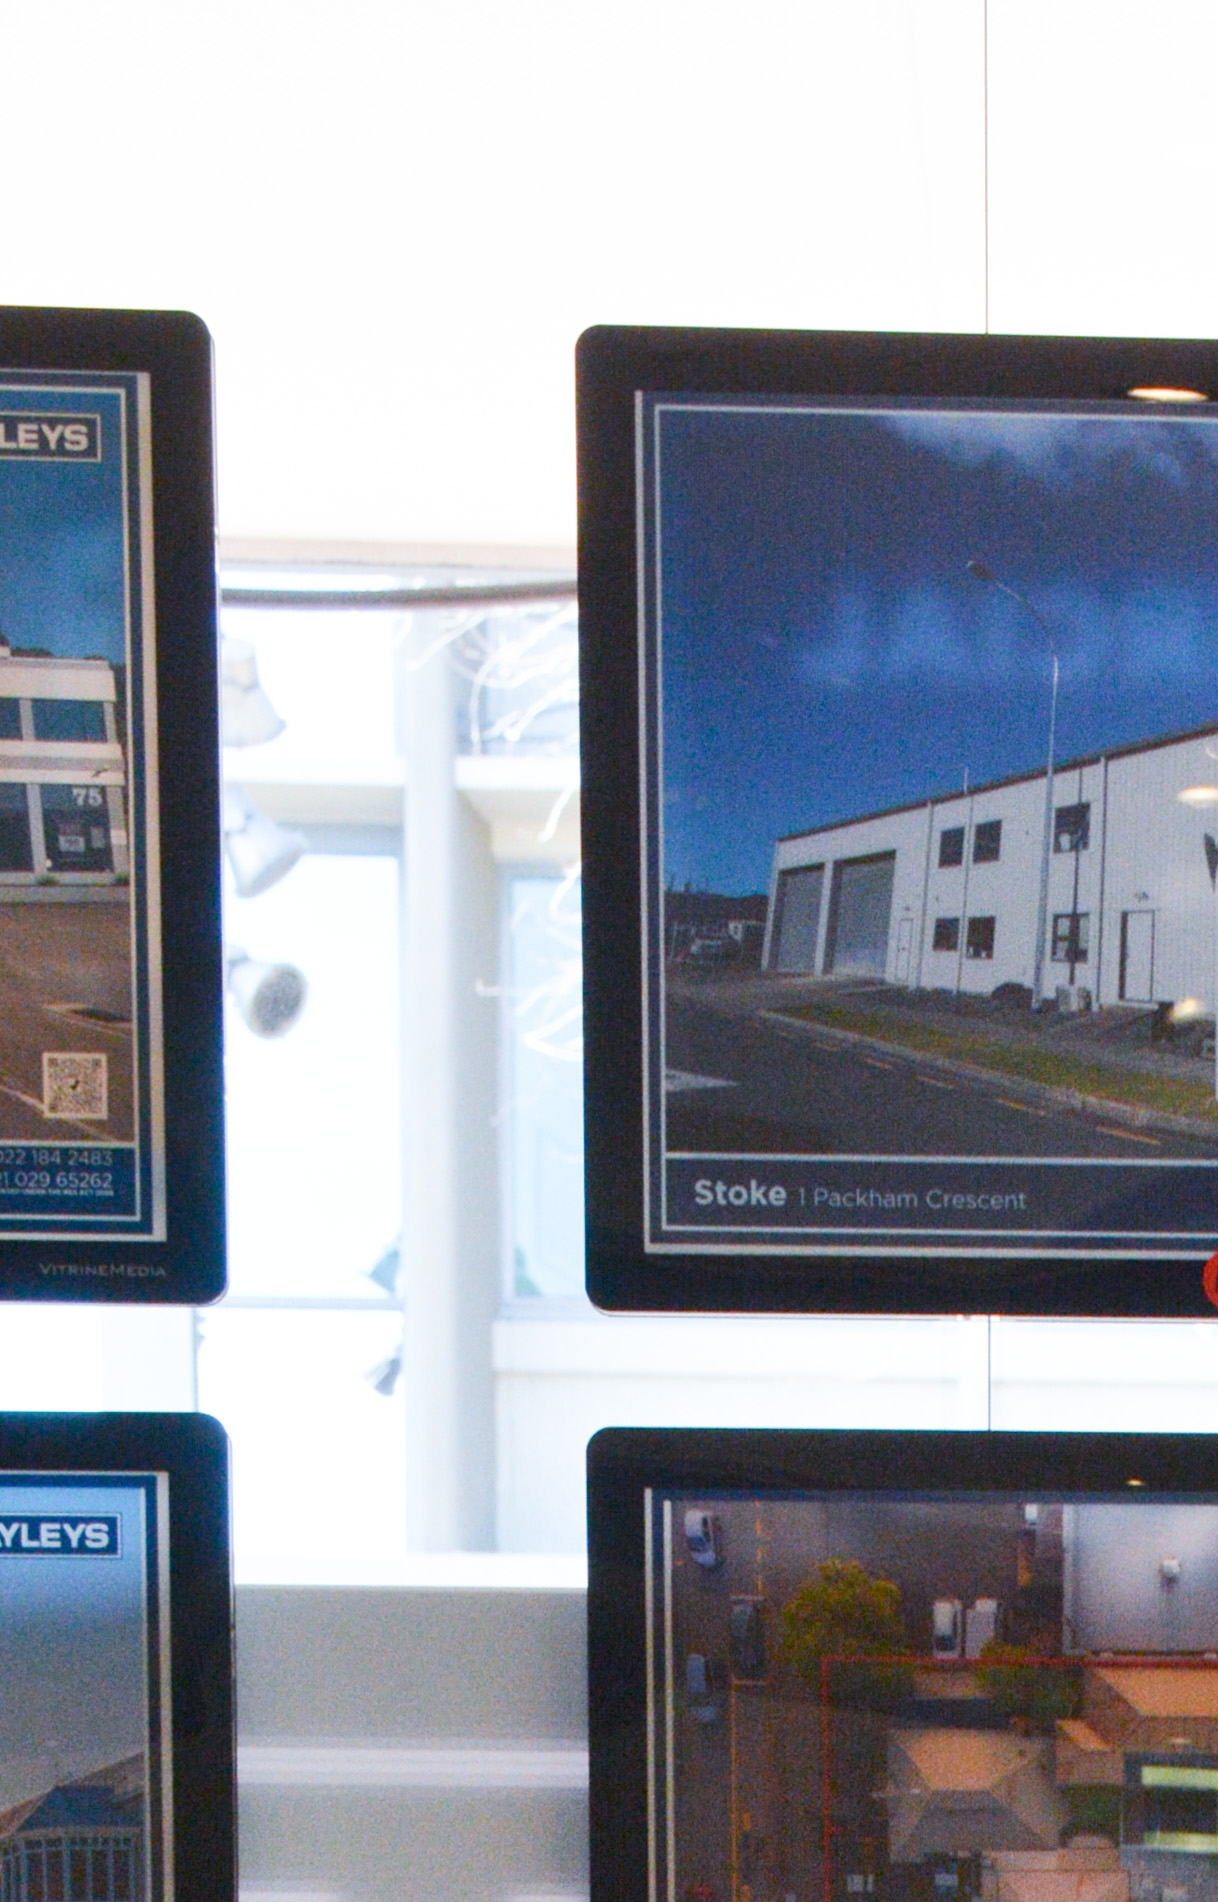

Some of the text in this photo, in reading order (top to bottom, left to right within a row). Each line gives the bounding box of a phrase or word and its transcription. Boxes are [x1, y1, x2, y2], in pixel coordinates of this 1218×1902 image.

[72, 786, 103, 807] 75
[0, 1150, 113, 1167] 22 184 2483
[15, 1172, 50, 1188] 029
[56, 1172, 113, 1189] 65262
[694, 1179, 787, 1207] Stoke
[814, 1187, 918, 1208] Packham
[926, 1189, 1027, 1210] Crescent
[0, 1522, 109, 1549] YLEYS
